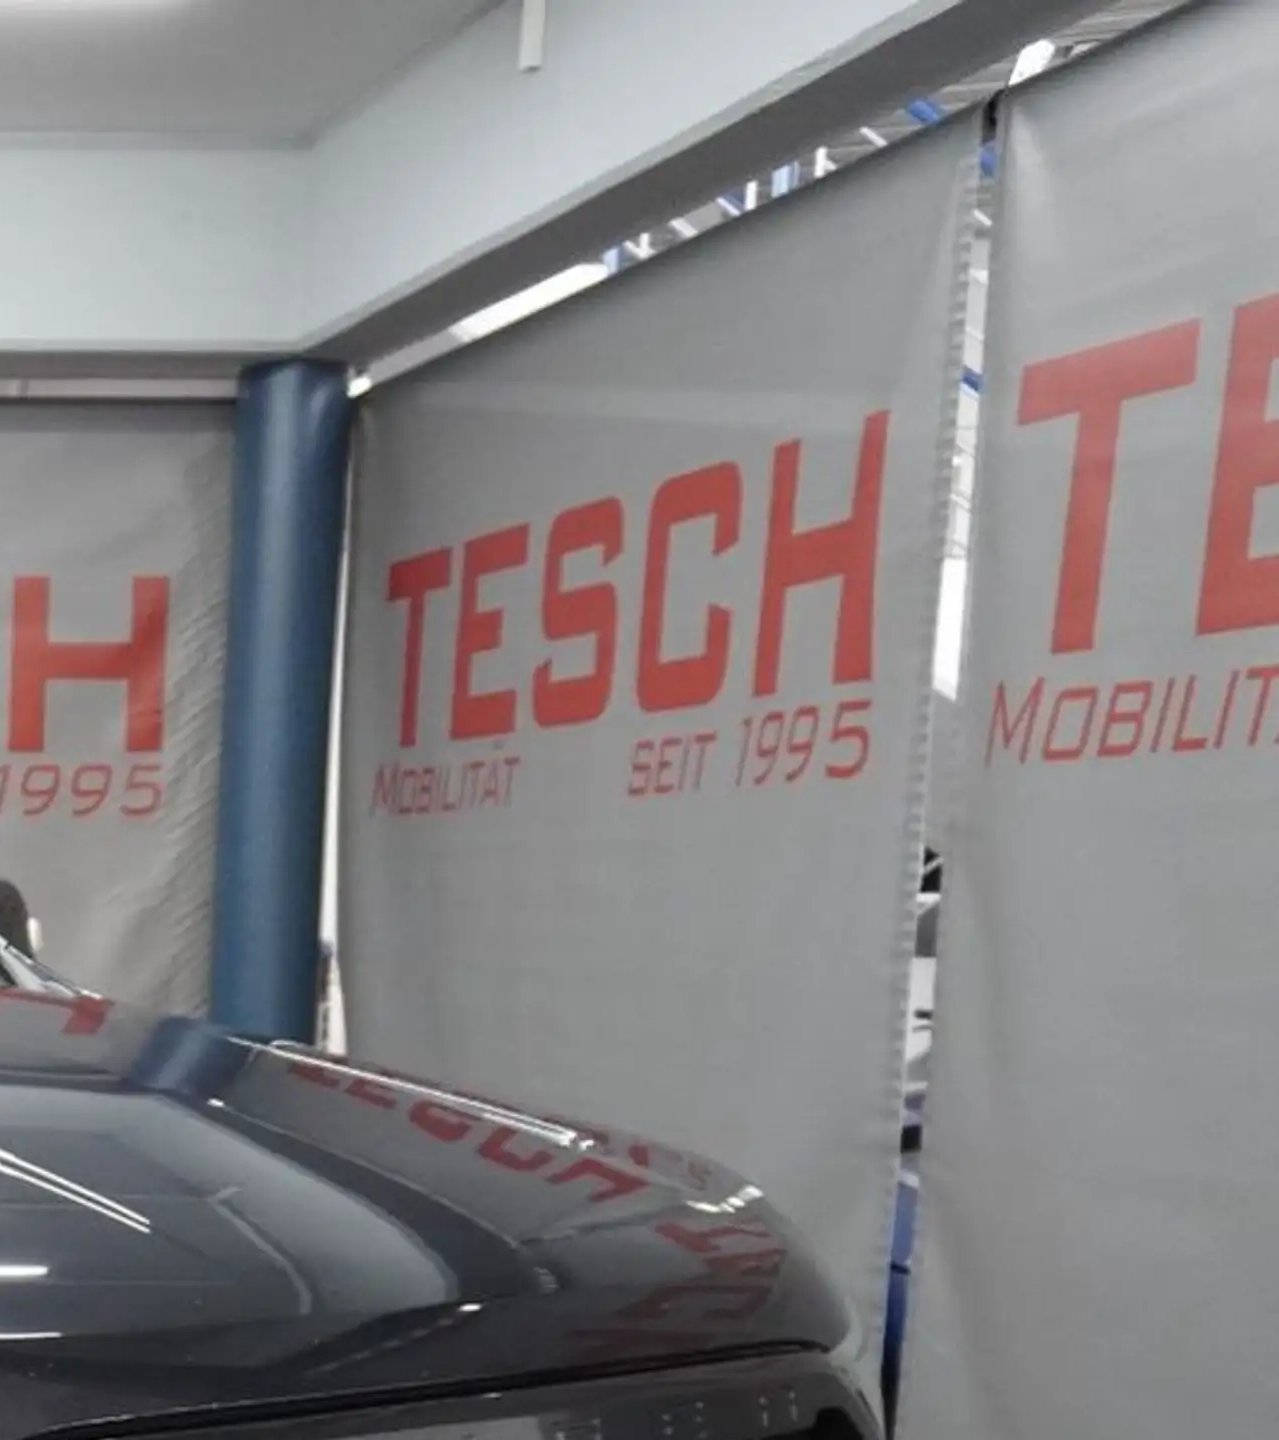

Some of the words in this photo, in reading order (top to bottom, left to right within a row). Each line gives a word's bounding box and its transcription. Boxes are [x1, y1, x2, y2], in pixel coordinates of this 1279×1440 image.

[387, 409, 890, 748] TESCH
[368, 738, 521, 816] MOBILITÄT
[627, 731, 717, 797] SEIT
[734, 699, 871, 787] 1995
